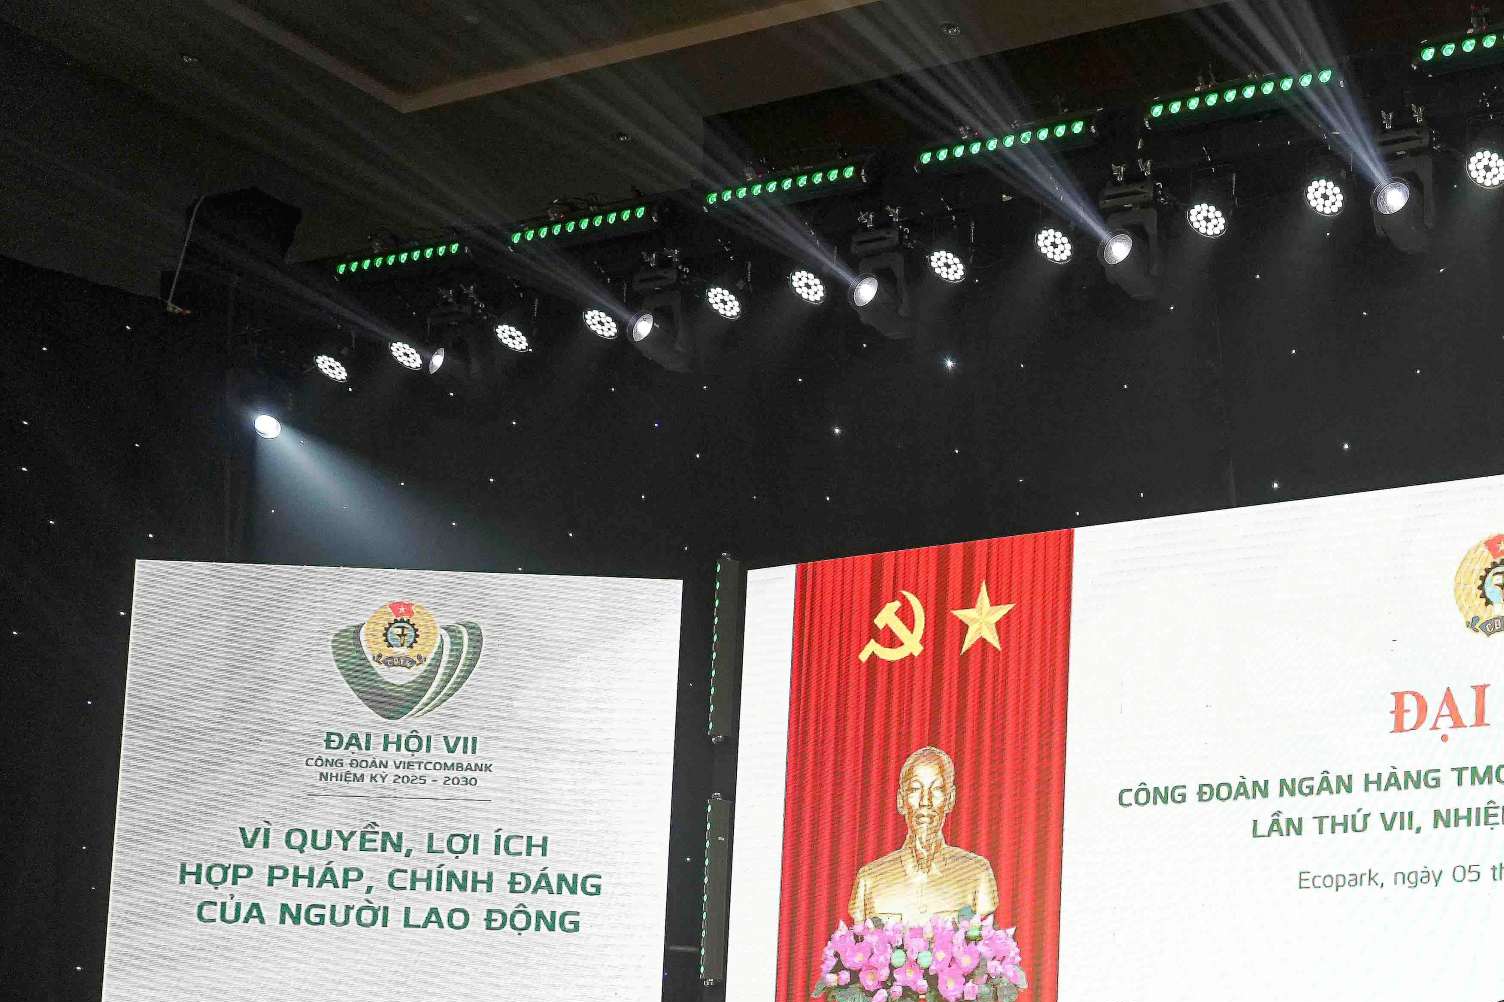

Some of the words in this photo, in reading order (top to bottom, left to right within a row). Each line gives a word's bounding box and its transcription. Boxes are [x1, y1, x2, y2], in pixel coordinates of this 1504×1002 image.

[1389, 683, 1491, 743] ĐẠI
[323, 731, 371, 755] ĐẠI
[382, 729, 431, 757] HỘI
[443, 735, 478, 755] VII
[305, 755, 344, 768] CÔNG
[348, 757, 388, 770] ĐOÀN
[393, 760, 493, 773] VIETCOMBANK
[319, 769, 365, 786] NHIỆM
[392, 774, 427, 785] 2025
[442, 776, 478, 787] 2030
[1118, 781, 1187, 809] CÔNG
[1197, 775, 1270, 803] ĐOÀN
[1279, 770, 1353, 799] NGÂN
[1364, 765, 1442, 793] HÀNG
[1251, 809, 1303, 839] LẦN
[1312, 807, 1371, 834] THỨ
[1379, 810, 1423, 834] VII,
[238, 820, 271, 849] VÌ
[284, 821, 413, 858] QUYỀN,
[426, 832, 479, 860] LỢI
[493, 828, 549, 857] ÍCH
[178, 861, 254, 889] HỢP
[267, 861, 374, 895] PHÁP,
[387, 864, 494, 894] CHÍNH
[507, 866, 602, 896] ĐÁNG
[1298, 867, 1386, 893] Ecopark,
[1393, 867, 1443, 889] ngày
[1452, 863, 1481, 884] 05
[196, 893, 266, 925] CỦA
[279, 899, 389, 928] NGƯỜI
[403, 906, 470, 930] LAO
[484, 903, 581, 936] ĐỘNG
